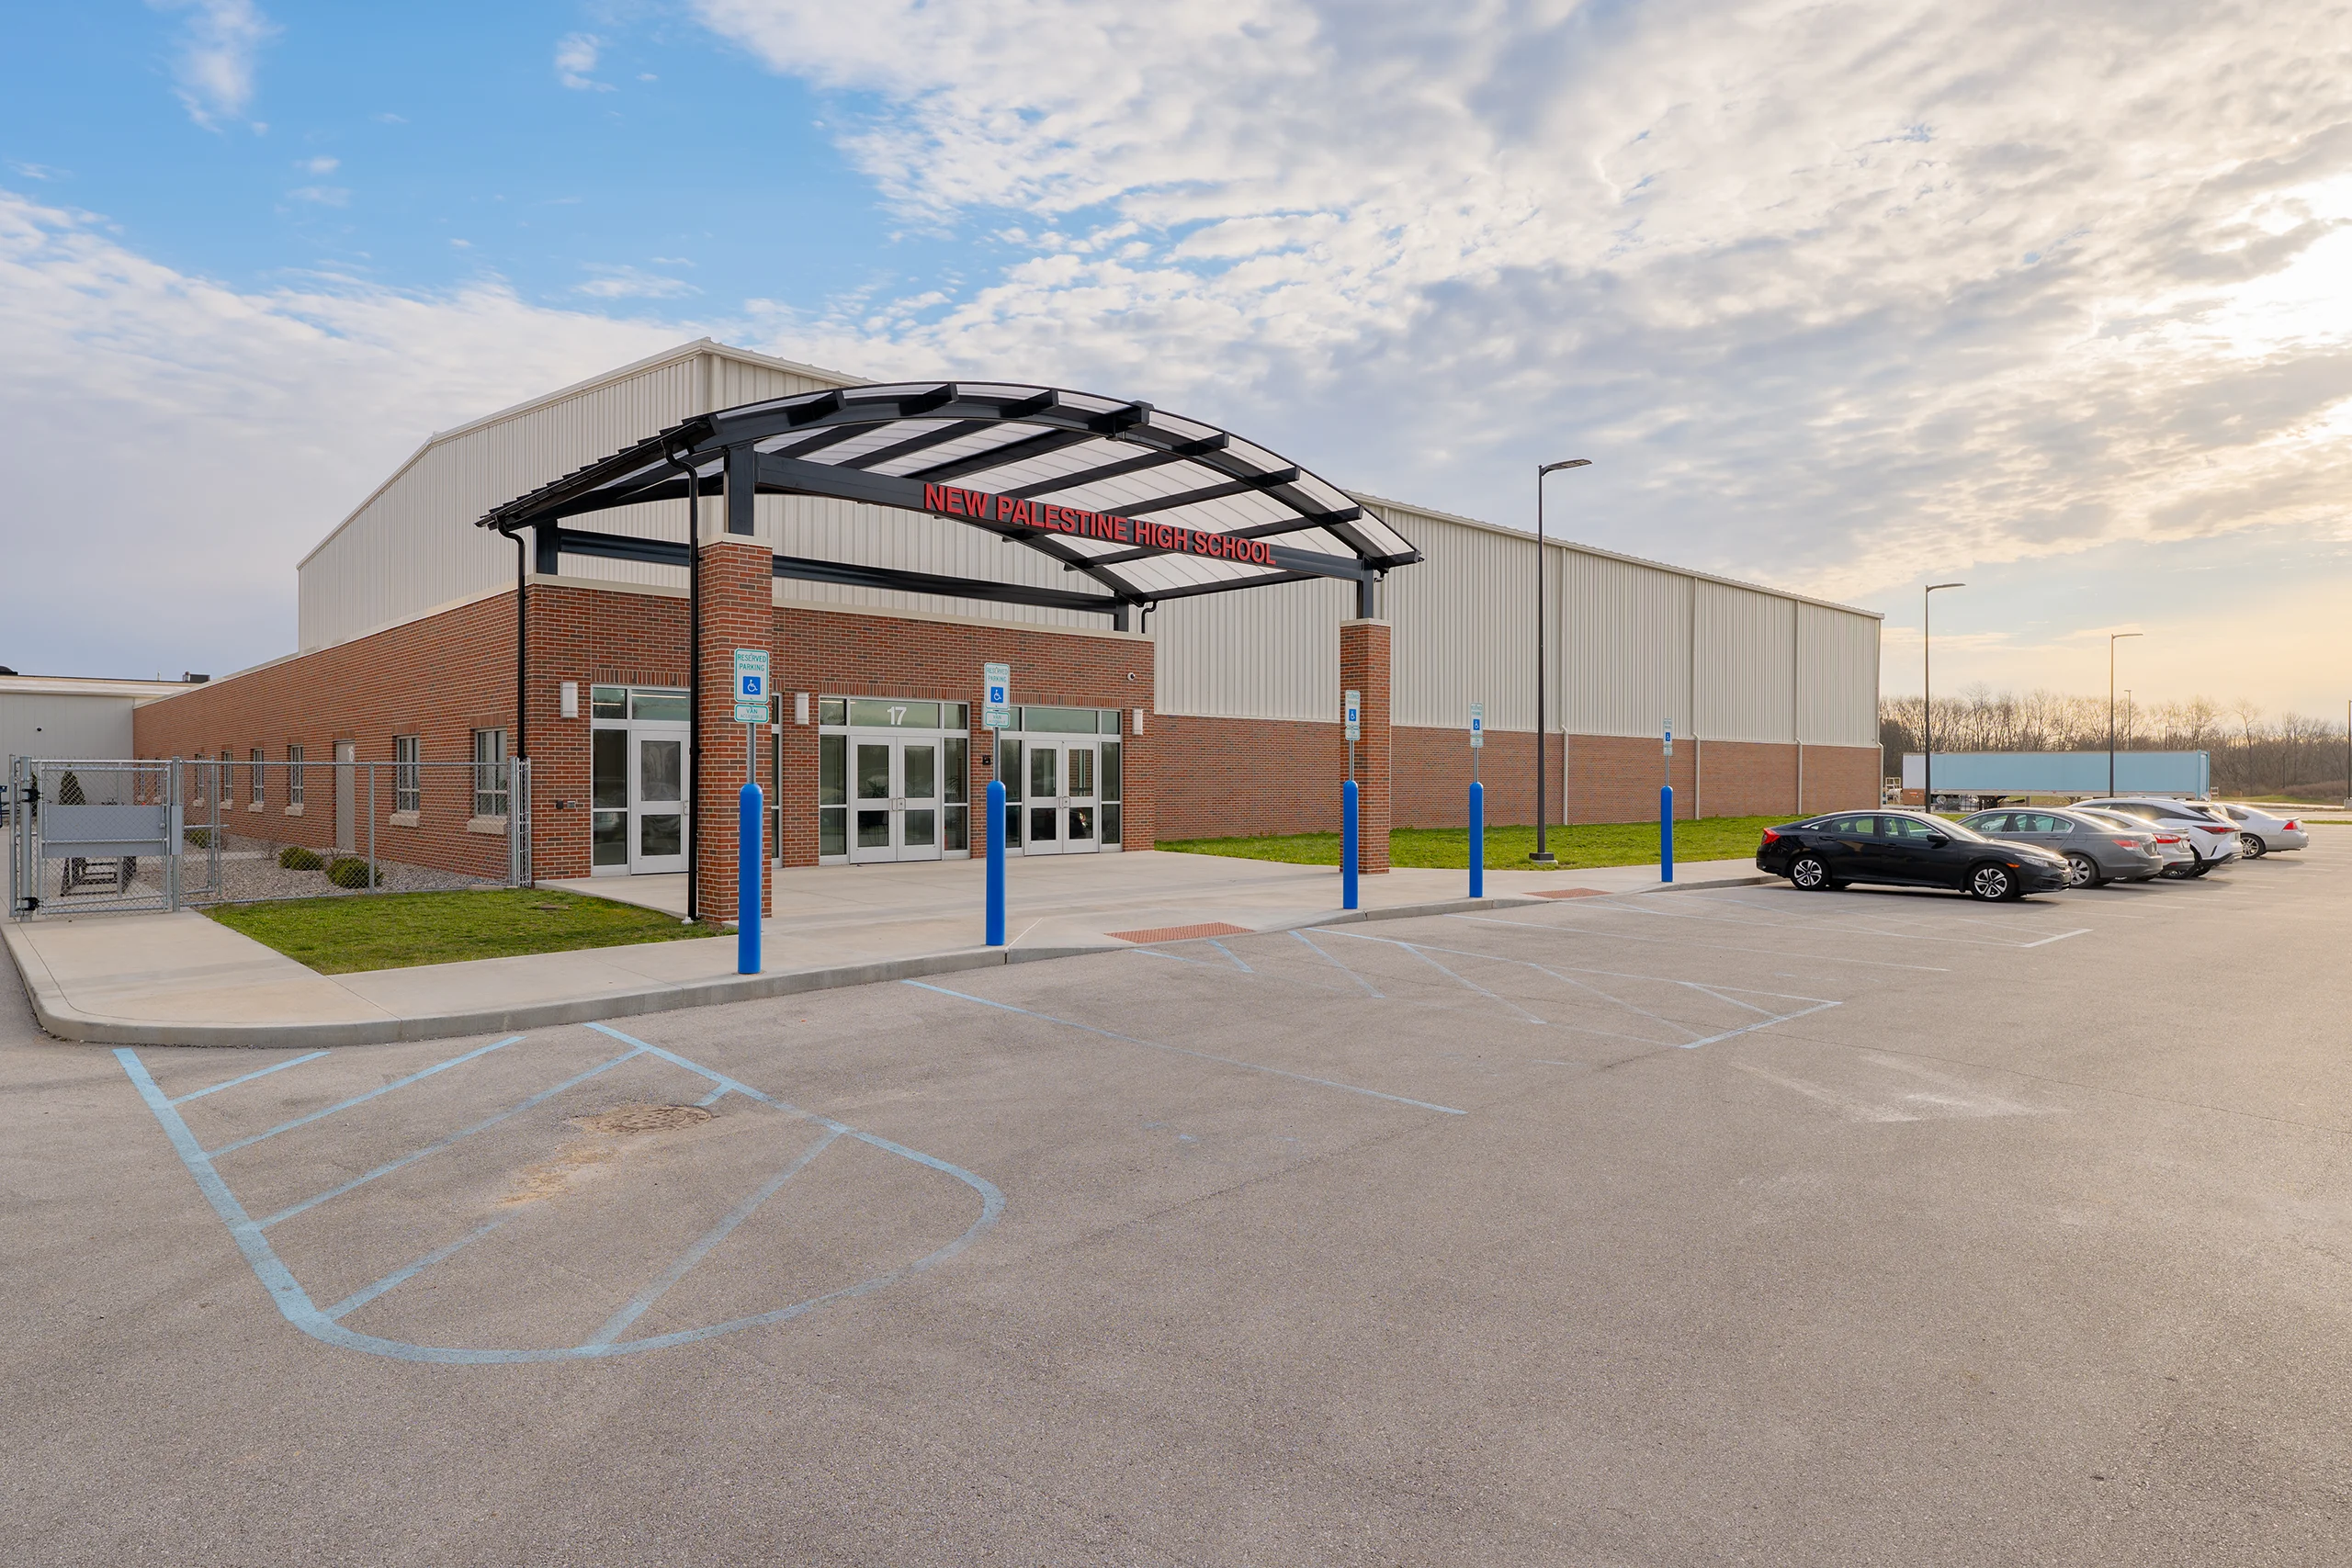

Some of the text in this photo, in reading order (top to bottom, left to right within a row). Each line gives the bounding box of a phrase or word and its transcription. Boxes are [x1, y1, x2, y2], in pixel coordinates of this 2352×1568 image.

[924, 483, 1276, 565] NEW PALESTINE HIGH SCHOOL
[737, 653, 767, 662] RESERVED
[739, 663, 764, 671] PARKING
[987, 667, 1008, 675] RESERVED
[888, 706, 907, 725] 17
